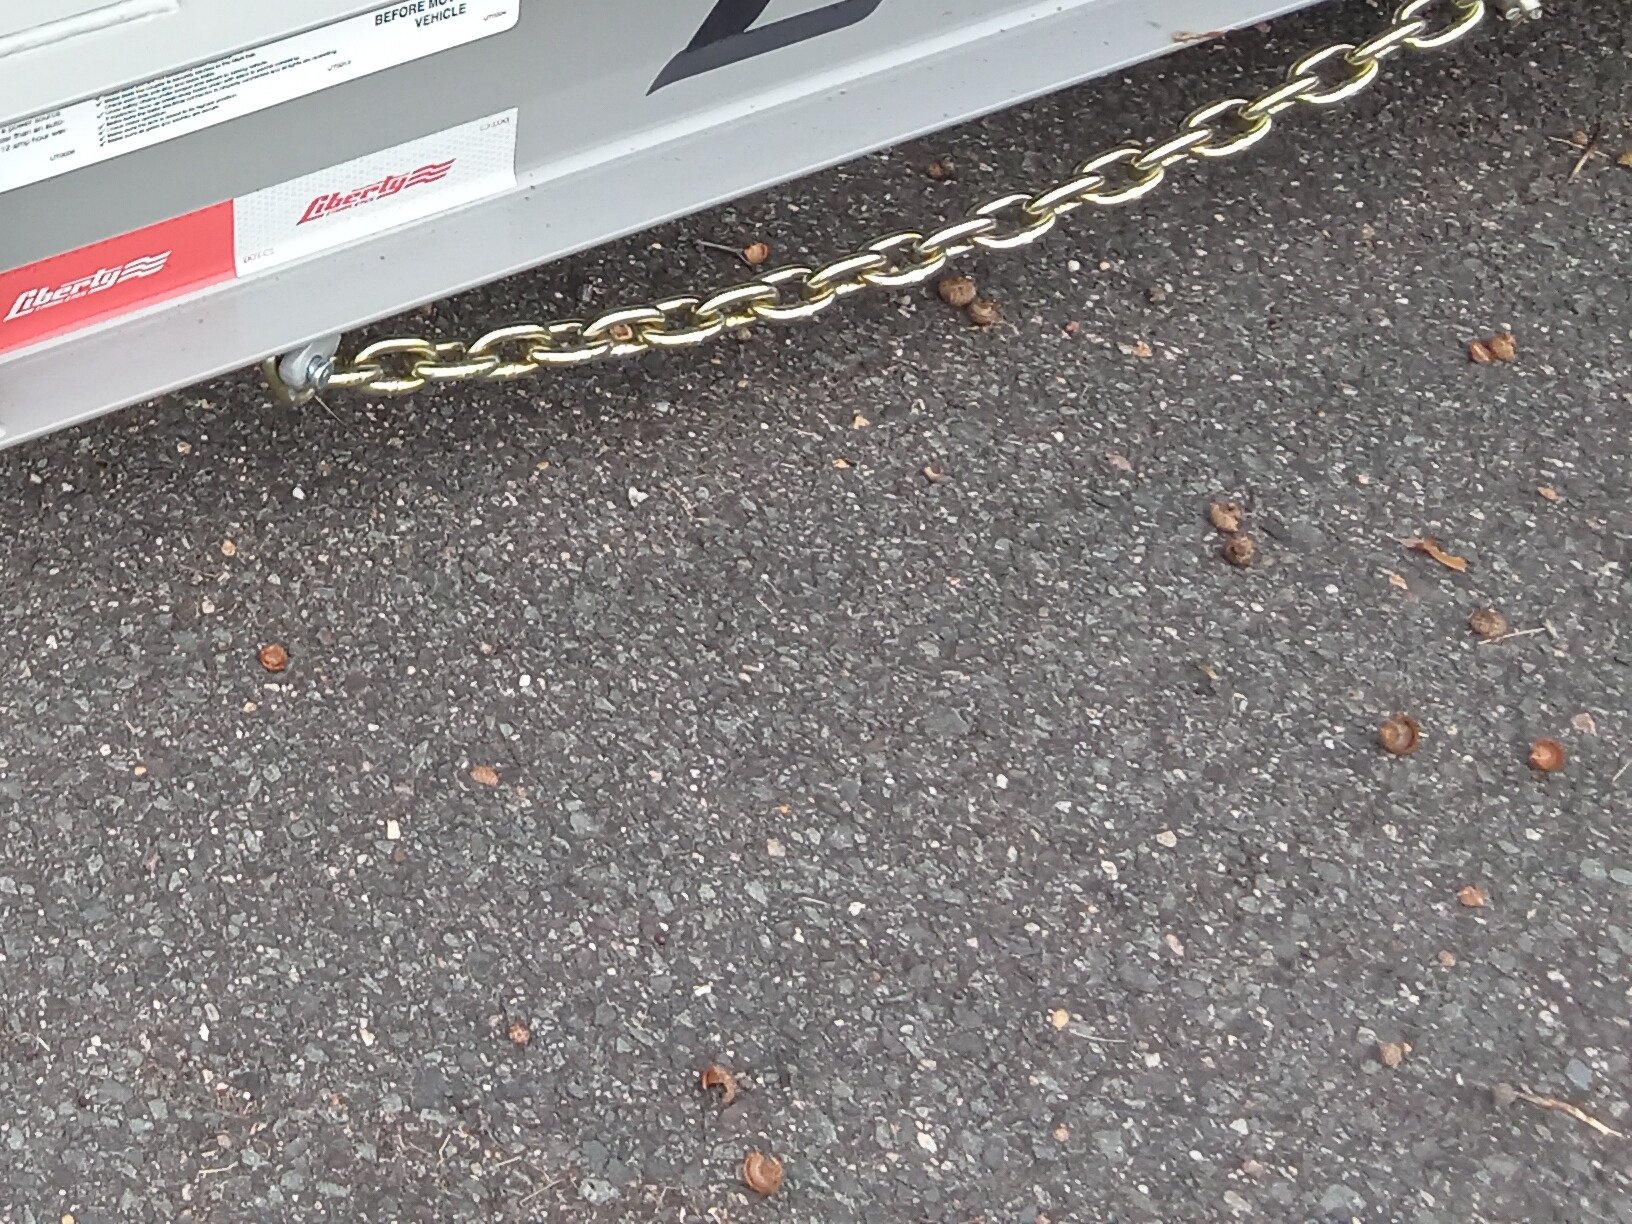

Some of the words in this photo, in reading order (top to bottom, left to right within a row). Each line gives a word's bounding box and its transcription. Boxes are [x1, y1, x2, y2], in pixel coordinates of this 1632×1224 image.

[374, 0, 427, 26] BEFORE
[414, 2, 467, 28] VEHICLE
[296, 172, 410, 226] Liberty
[3, 265, 124, 323] Liberty
